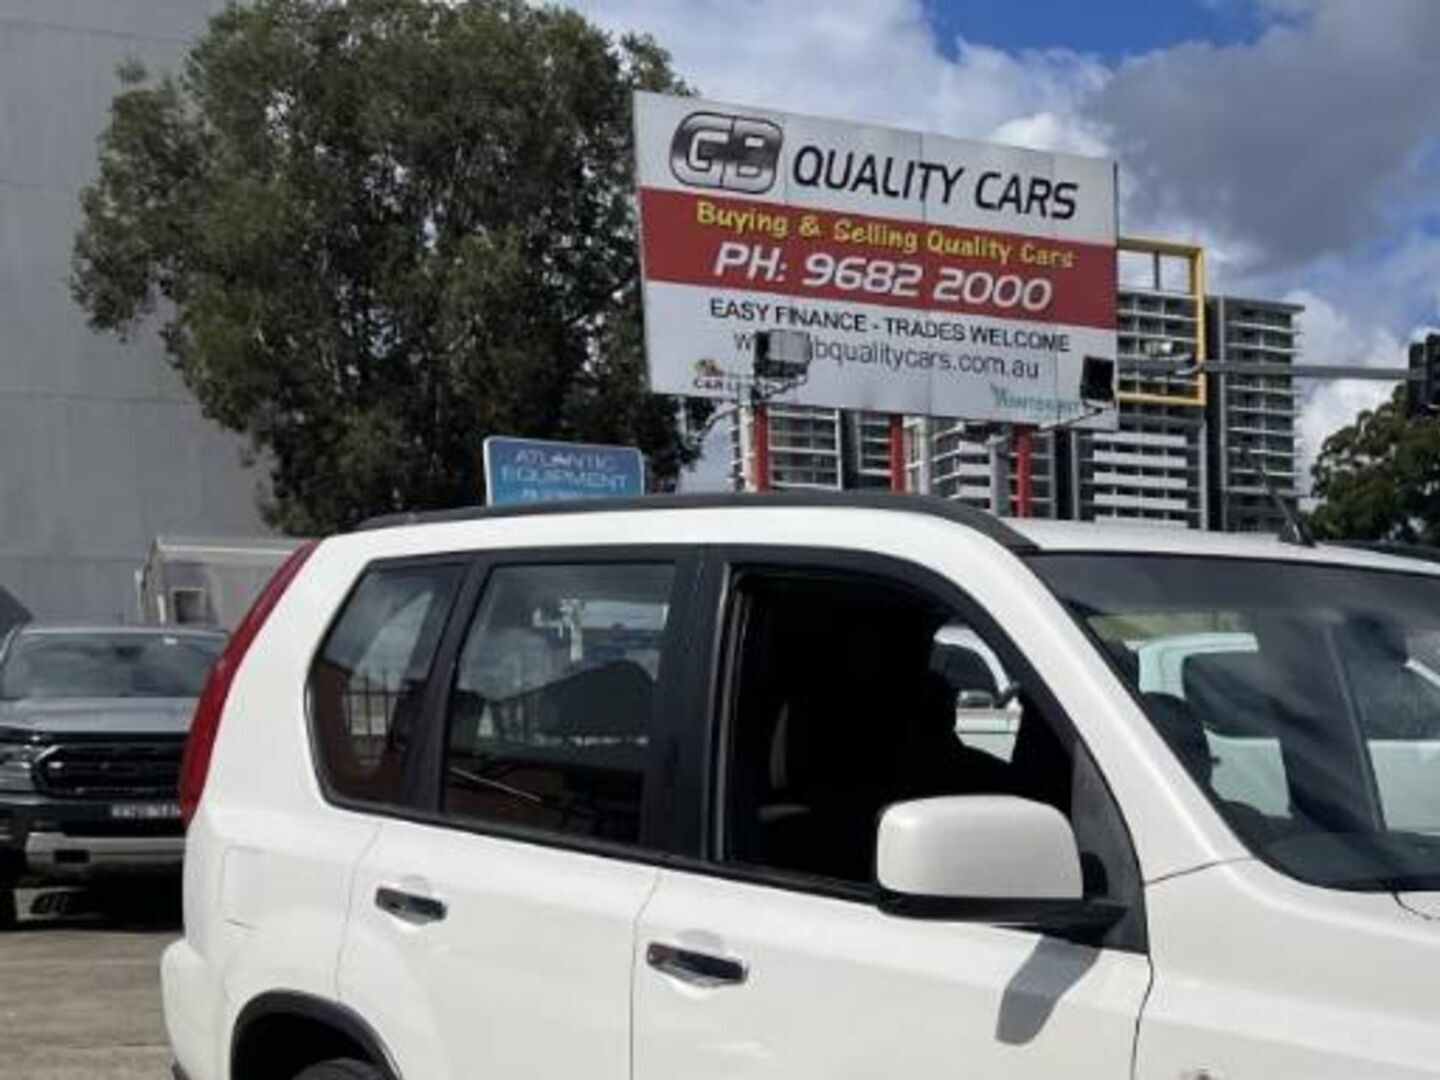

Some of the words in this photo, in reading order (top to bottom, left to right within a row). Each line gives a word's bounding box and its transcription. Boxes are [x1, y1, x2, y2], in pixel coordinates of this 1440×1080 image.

[669, 111, 784, 194] GB
[792, 145, 966, 204] QUALITY
[974, 169, 1079, 220] CARS
[697, 202, 789, 238] Buying
[800, 214, 822, 237] &
[834, 219, 919, 255] Selling
[927, 229, 1013, 266] Quality
[1020, 244, 1076, 268] Cars
[714, 241, 786, 283] PH:
[802, 252, 923, 297] 9682
[933, 267, 1053, 311] 2000
[710, 298, 769, 321] EASY
[775, 306, 868, 333] FINANCE
[884, 317, 966, 342] TRADES
[970, 325, 1072, 353] WELCOME
